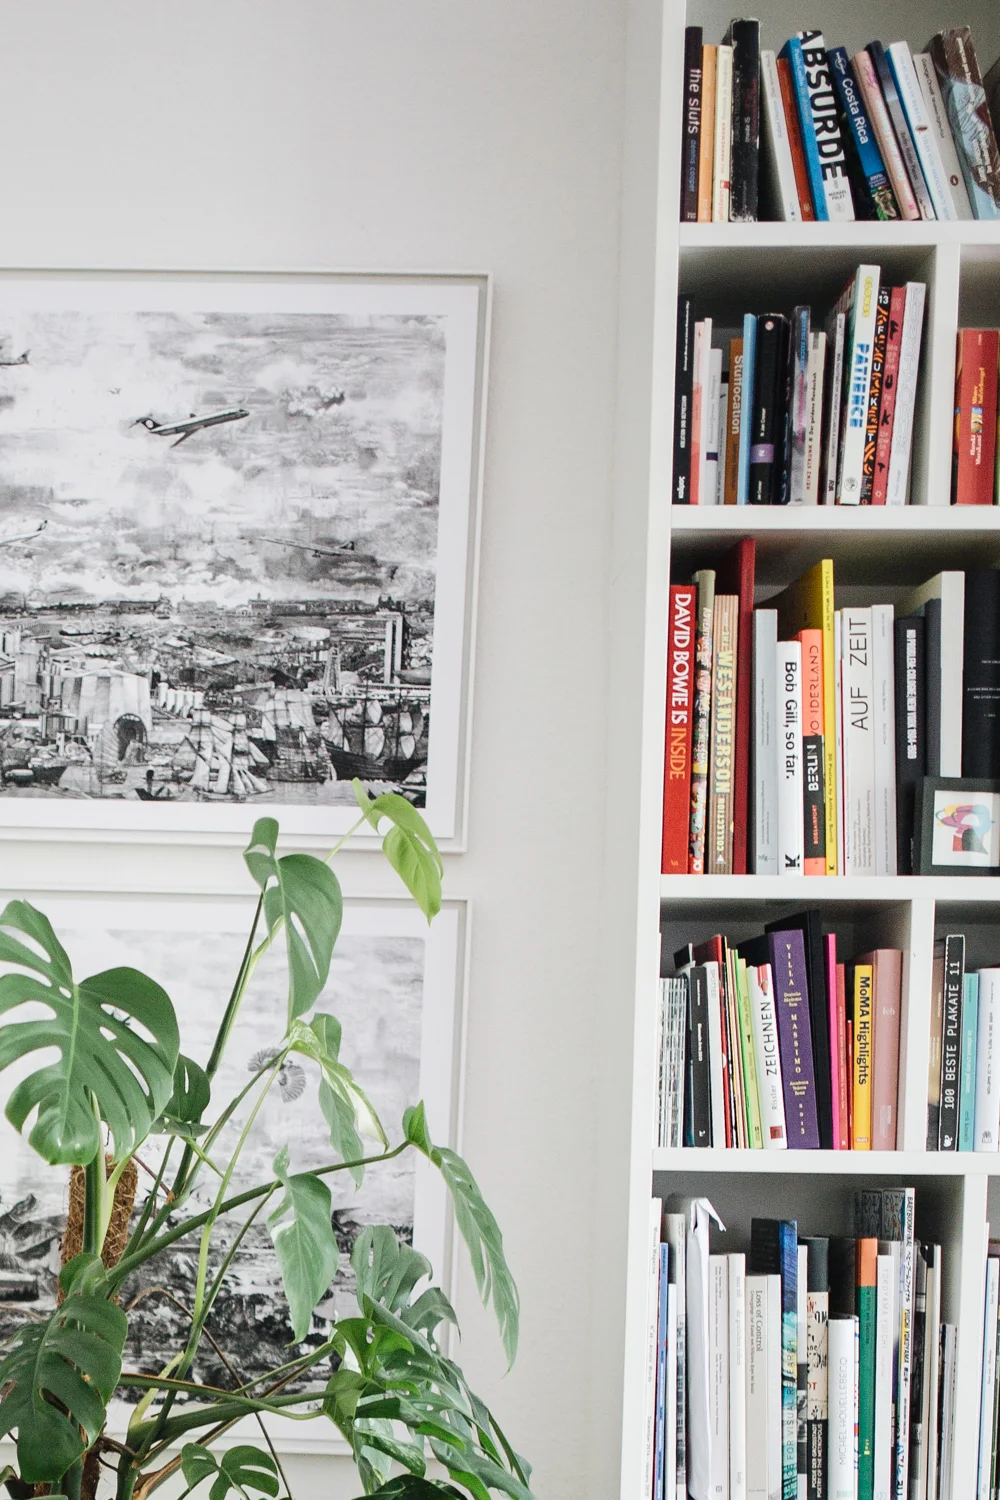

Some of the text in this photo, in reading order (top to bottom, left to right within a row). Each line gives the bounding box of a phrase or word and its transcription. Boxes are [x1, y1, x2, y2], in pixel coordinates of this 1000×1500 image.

[687, 69, 701, 134] the sluts
[799, 30, 846, 181] ABSURDE
[842, 78, 870, 144] Costa Rica
[861, 276, 873, 318] CLOWES
[878, 295, 889, 305] 13
[849, 343, 870, 428] PATIENCE
[669, 593, 692, 780] DAVID BOWIE IS INSIDE
[849, 618, 868, 730] AUF ZEIT
[715, 650, 732, 794] WES ANDERSON
[784, 662, 798, 780] Bob Gill, so far.
[807, 745, 820, 791] BERLIN
[786, 944, 795, 986] VILLA
[791, 1014, 802, 1073] MASSIMO
[857, 976, 870, 1085] MoMA Highlights
[882, 1006, 895, 1016] Ich
[945, 961, 960, 1109] 100 BESTE PLAKATE 11
[760, 1001, 778, 1110] Rissler ZEICHNEN
[755, 1290, 763, 1352] Loss of Control
[785, 1339, 794, 1497] SPACE FOR VISUAL RESEARCH
[839, 1429, 847, 1465] MICHEL
